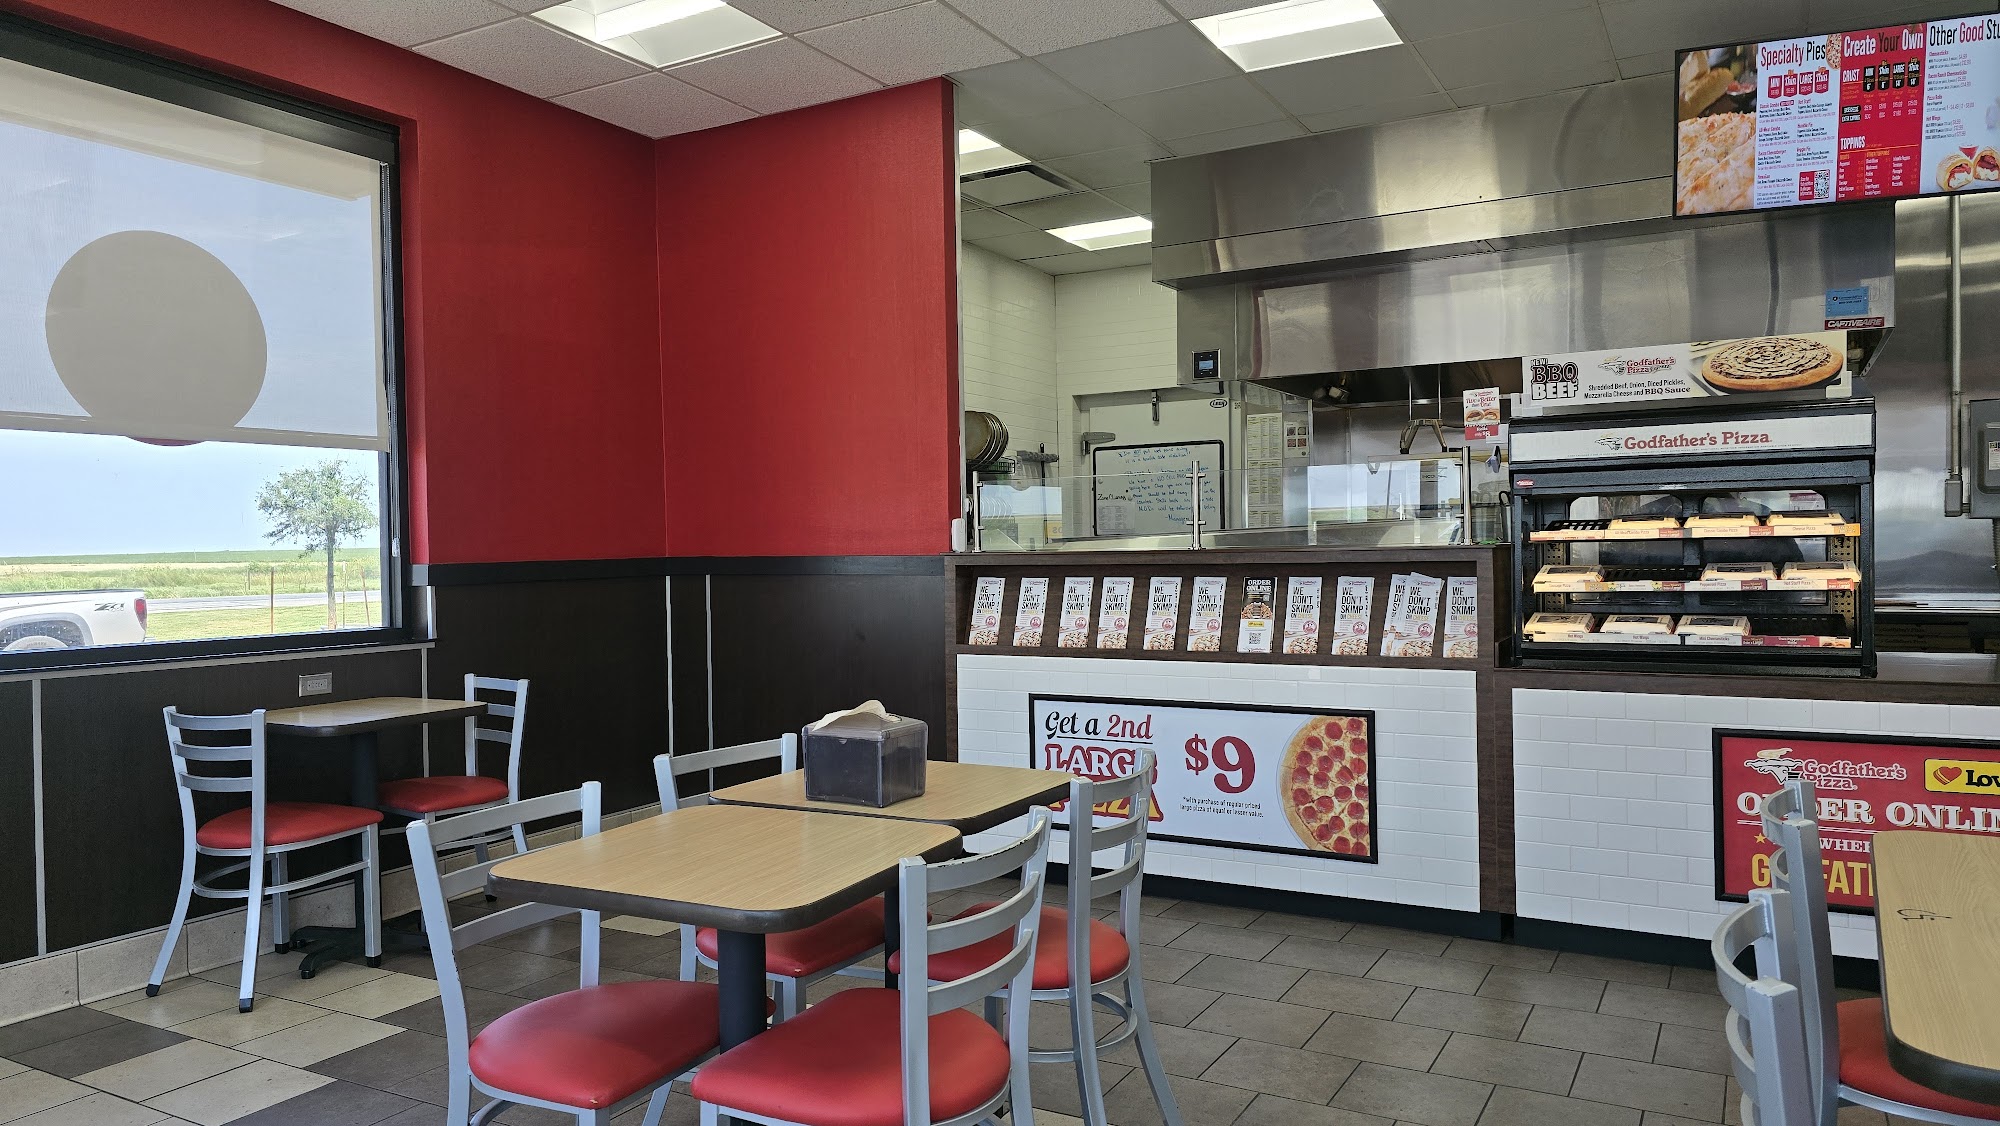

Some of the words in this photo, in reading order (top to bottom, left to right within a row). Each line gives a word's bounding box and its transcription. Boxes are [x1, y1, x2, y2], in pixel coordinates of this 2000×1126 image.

[1929, 25, 1958, 46] Other
[1959, 20, 1984, 43] Good
[1844, 35, 1876, 57] Create
[1879, 32, 1900, 53] Your
[1902, 29, 1924, 50] Own
[1761, 43, 1804, 70] Specialty
[1806, 41, 1826, 61] Pies
[1843, 69, 1860, 83] CRUST
[1840, 136, 1865, 150] TOPPINGS
[1626, 357, 1676, 367] Godfather's
[1531, 362, 1578, 384] BBQ
[1626, 366, 1649, 374] Pizza
[1588, 383, 1614, 391] Shredded
[1614, 382, 1629, 390] Beef,
[1647, 379, 1662, 387] Diced
[1531, 381, 1578, 400] BEEF
[1584, 391, 1612, 399] Mozzarella
[1644, 387, 1664, 395] BBQ
[1664, 386, 1691, 394] Sauce
[1624, 432, 1718, 450] Godfather's
[1721, 431, 1770, 445] Pizza
[1024, 586, 1033, 594] WE
[1068, 586, 1077, 594] WE
[1106, 586, 1116, 594] WE
[1154, 586, 1164, 594] WE
[1198, 586, 1209, 595] WE
[1293, 586, 1304, 595] WE
[1342, 586, 1354, 596] WE
[1410, 586, 1423, 596] WE
[1452, 586, 1465, 596] WE
[979, 593, 996, 602] DON'T
[1023, 594, 1040, 602] DON'T
[1067, 594, 1085, 602] DON'T
[1105, 594, 1125, 603] DON'T
[1153, 594, 1173, 603] DON'T
[1197, 594, 1218, 604] DON'T
[1292, 595, 1314, 604] DON'T
[1341, 595, 1363, 605] DON'T
[1408, 595, 1431, 606] DON'T
[1451, 596, 1475, 606] DON'T
[977, 601, 996, 610] SKIMP
[1022, 601, 1040, 610] SKIMP
[1066, 602, 1085, 611] SKIMP
[1104, 602, 1125, 611] SKIMP
[1152, 603, 1173, 612] SKIMP
[1196, 603, 1218, 612] SKIMP
[1291, 604, 1314, 613] SKIMP
[1340, 605, 1364, 614] SKIMP
[1407, 605, 1431, 615] SKIMP
[1451, 605, 1476, 615] SKIMP
[1045, 711, 1082, 740] Get
[1085, 718, 1102, 736] a
[1106, 714, 1153, 739] 2nd
[1045, 743, 1157, 784] LARG
[1184, 734, 1256, 794] $9
[1803, 759, 1907, 781] Godfather's
[1179, 803, 1192, 812] large
[1212, 807, 1226, 815] equal
[1226, 801, 1244, 809] regular
[1737, 791, 1875, 825] OER
